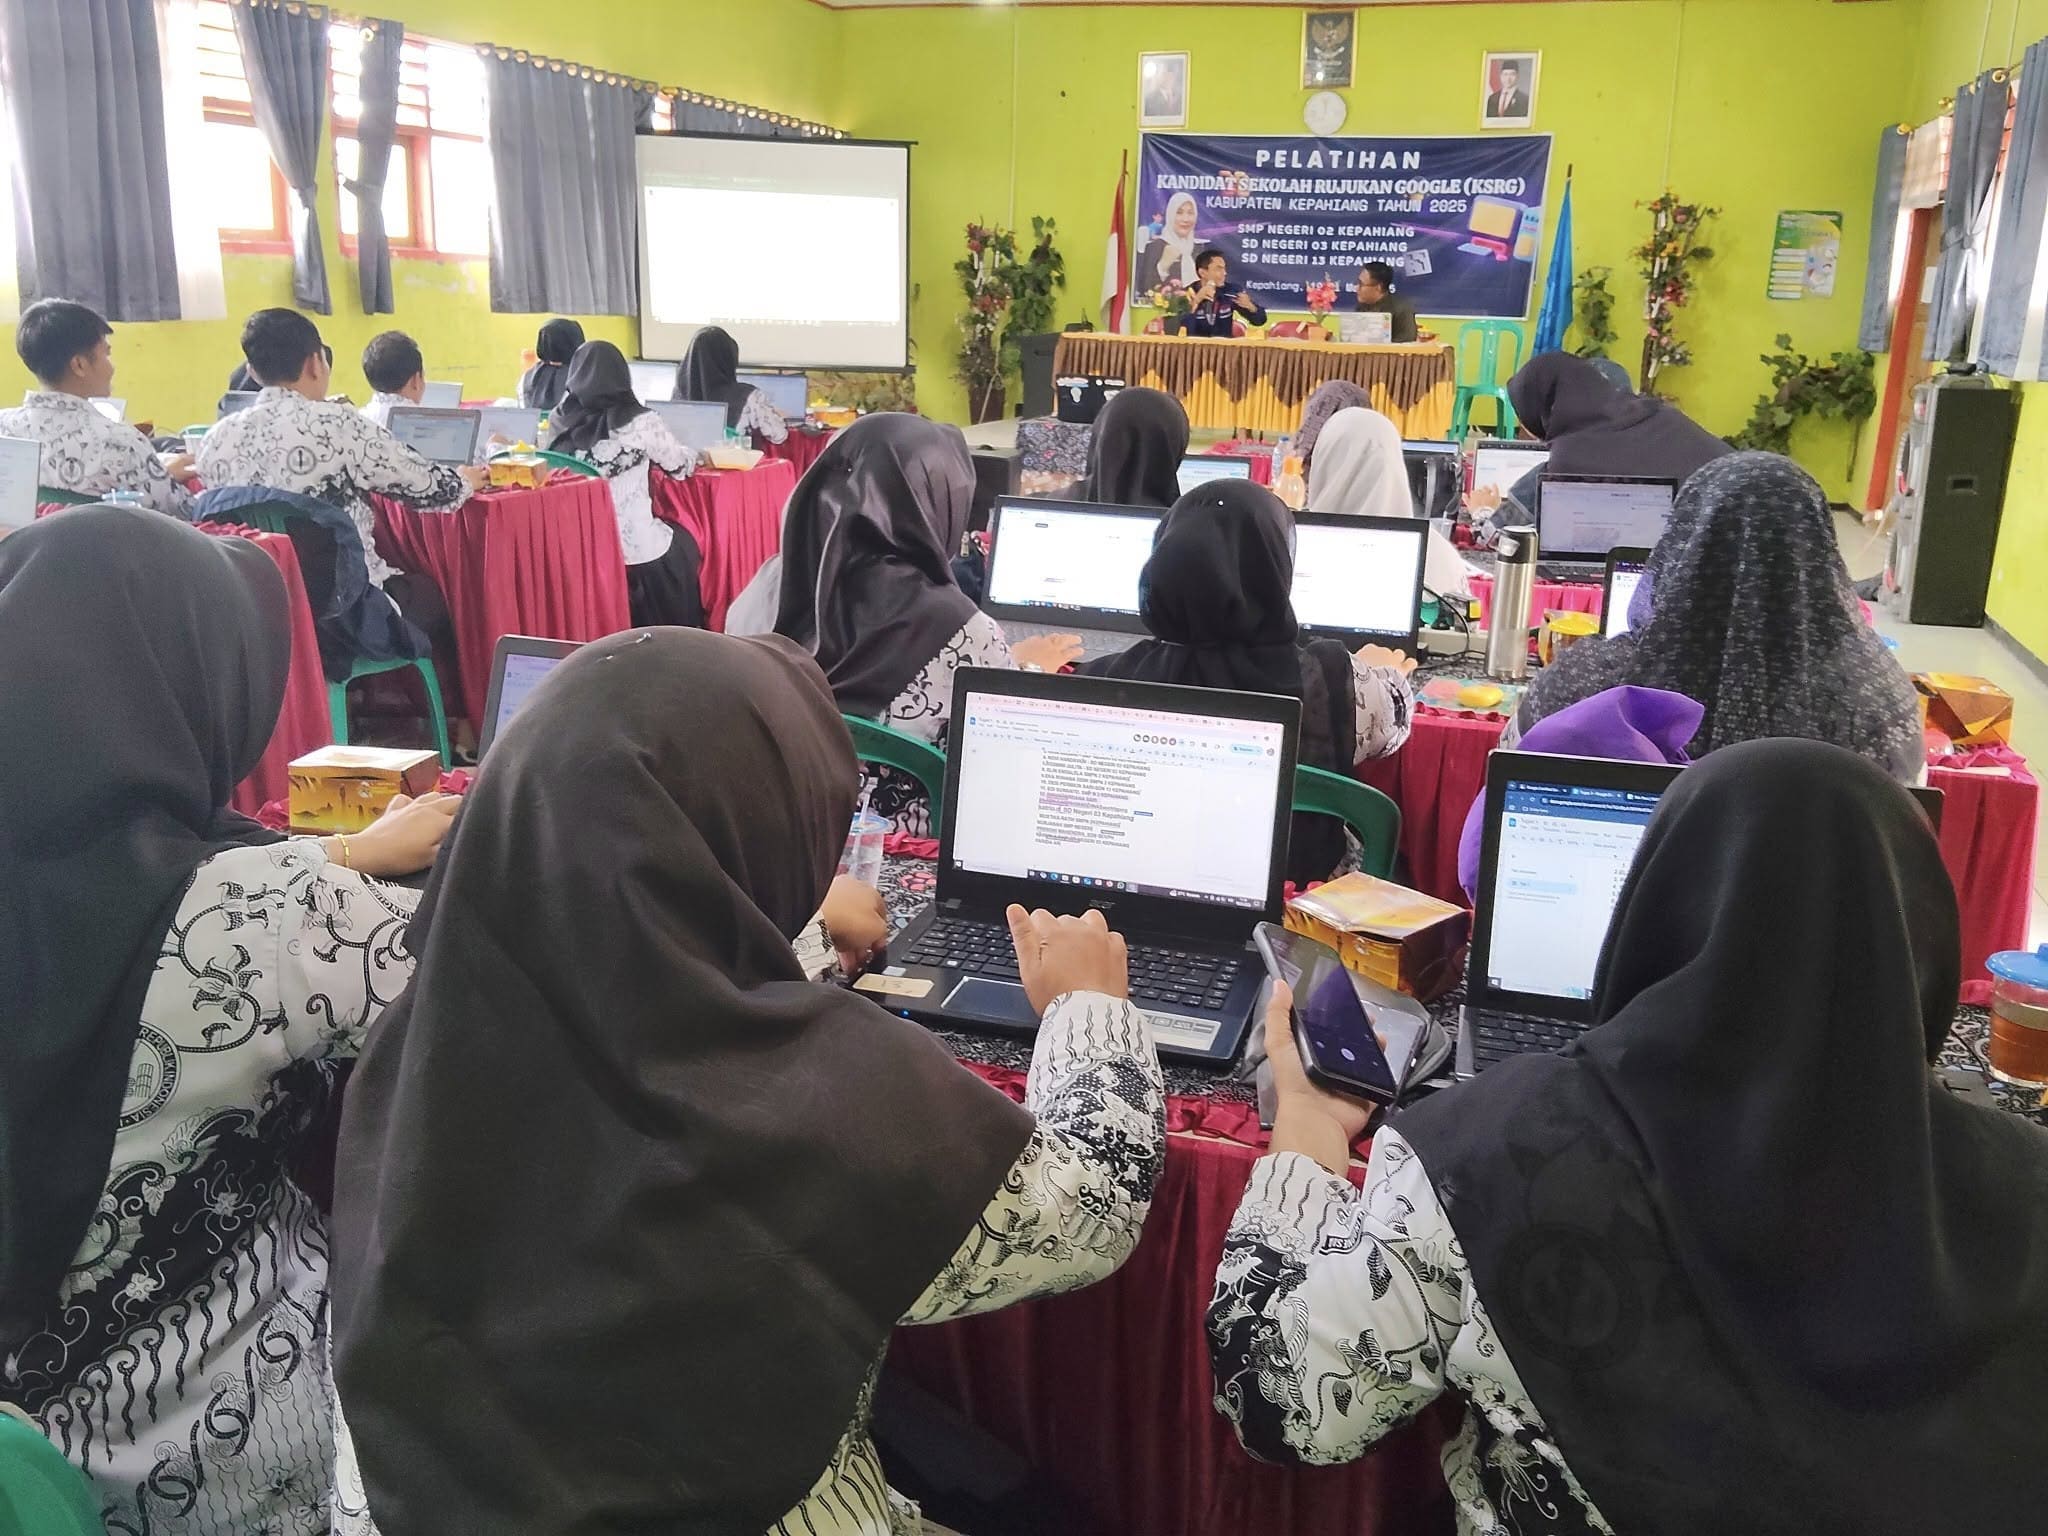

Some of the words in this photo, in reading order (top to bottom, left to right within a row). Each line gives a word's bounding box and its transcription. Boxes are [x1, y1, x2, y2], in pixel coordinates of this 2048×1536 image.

[1256, 150, 1421, 170] PELATIHAN
[1157, 174, 1236, 191] KANDIDAT
[1238, 177, 1312, 194] SEKOLAH
[1314, 178, 1393, 195] RUJUKAN
[1394, 178, 1462, 195] GOOGLE
[1463, 176, 1527, 197] (KSRG)
[1205, 196, 1281, 210] KABUPATEN
[1288, 198, 1369, 212] KEPAHIANG
[1378, 199, 1422, 213] TAHUN
[1429, 199, 1467, 213] 2025
[1237, 223, 1264, 235] SMP
[1267, 224, 1314, 236] NEGERI
[1317, 226, 1335, 237] 02
[1337, 225, 1415, 238] KEPAHIANG
[1241, 238, 1259, 250] SD
[1262, 239, 1308, 251] NEGERI
[1311, 241, 1328, 251] 03
[1331, 241, 1408, 253] KEPAHIANG
[1241, 253, 1259, 264] SD
[1261, 254, 1308, 266] NEGERI
[1311, 255, 1327, 266] 13
[139, 1026, 177, 1071] REPUBLIK
[130, 1070, 177, 1123] INDONESIA
